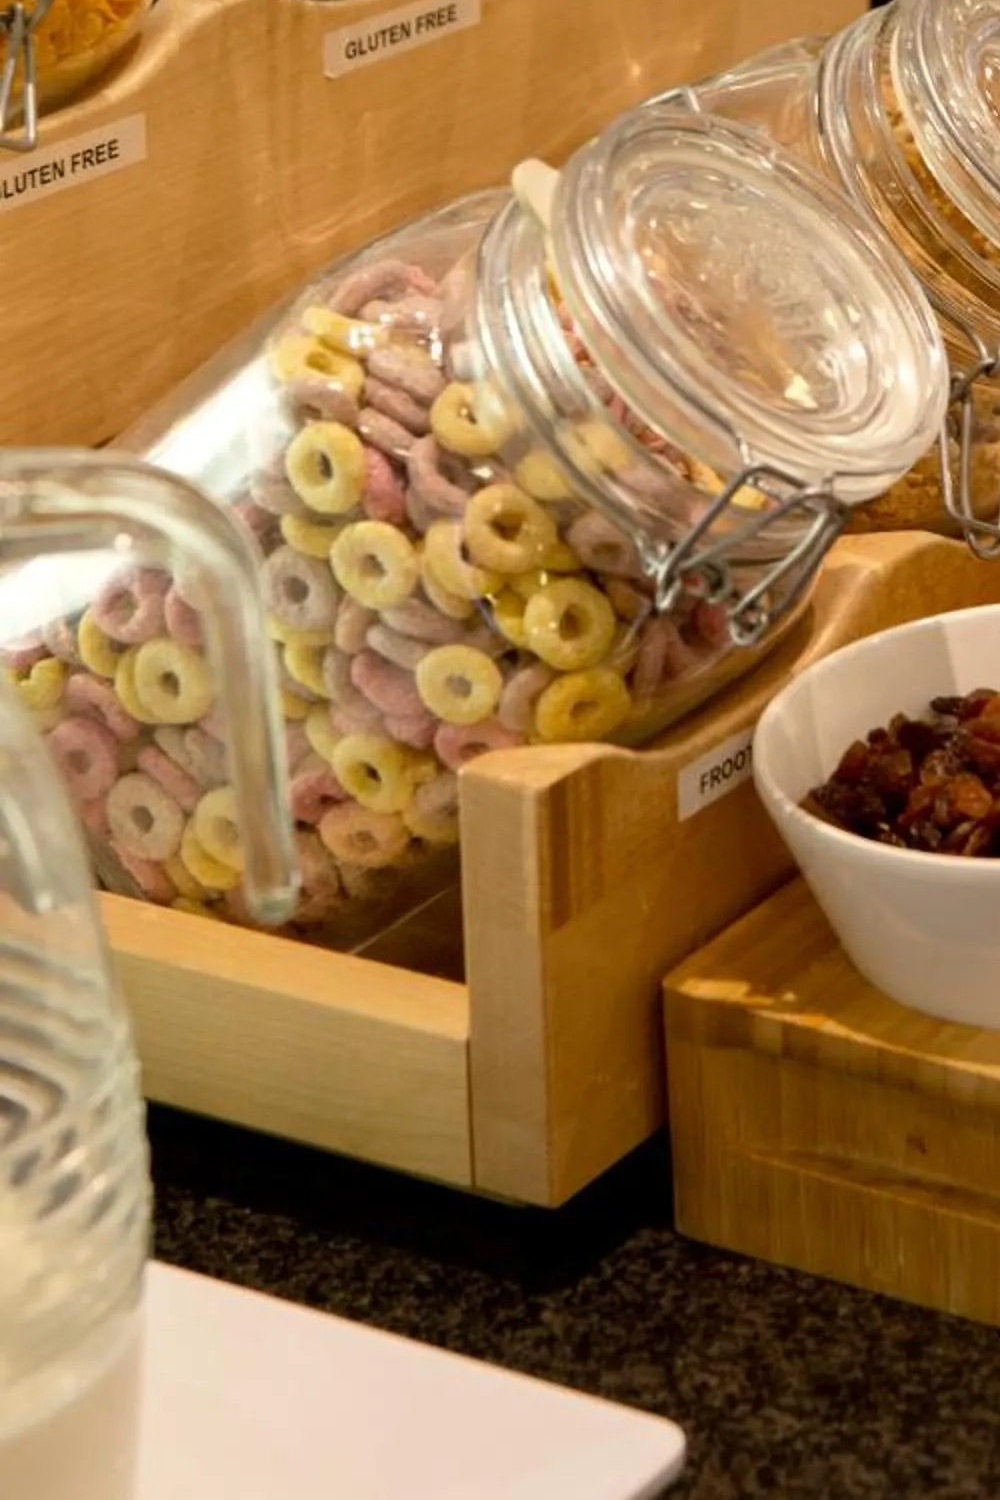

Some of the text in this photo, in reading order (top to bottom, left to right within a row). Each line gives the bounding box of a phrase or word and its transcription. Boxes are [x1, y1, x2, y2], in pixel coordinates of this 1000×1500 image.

[344, 3, 458, 60] GLUTEN FREE
[0, 138, 120, 199] LUTEN FREE
